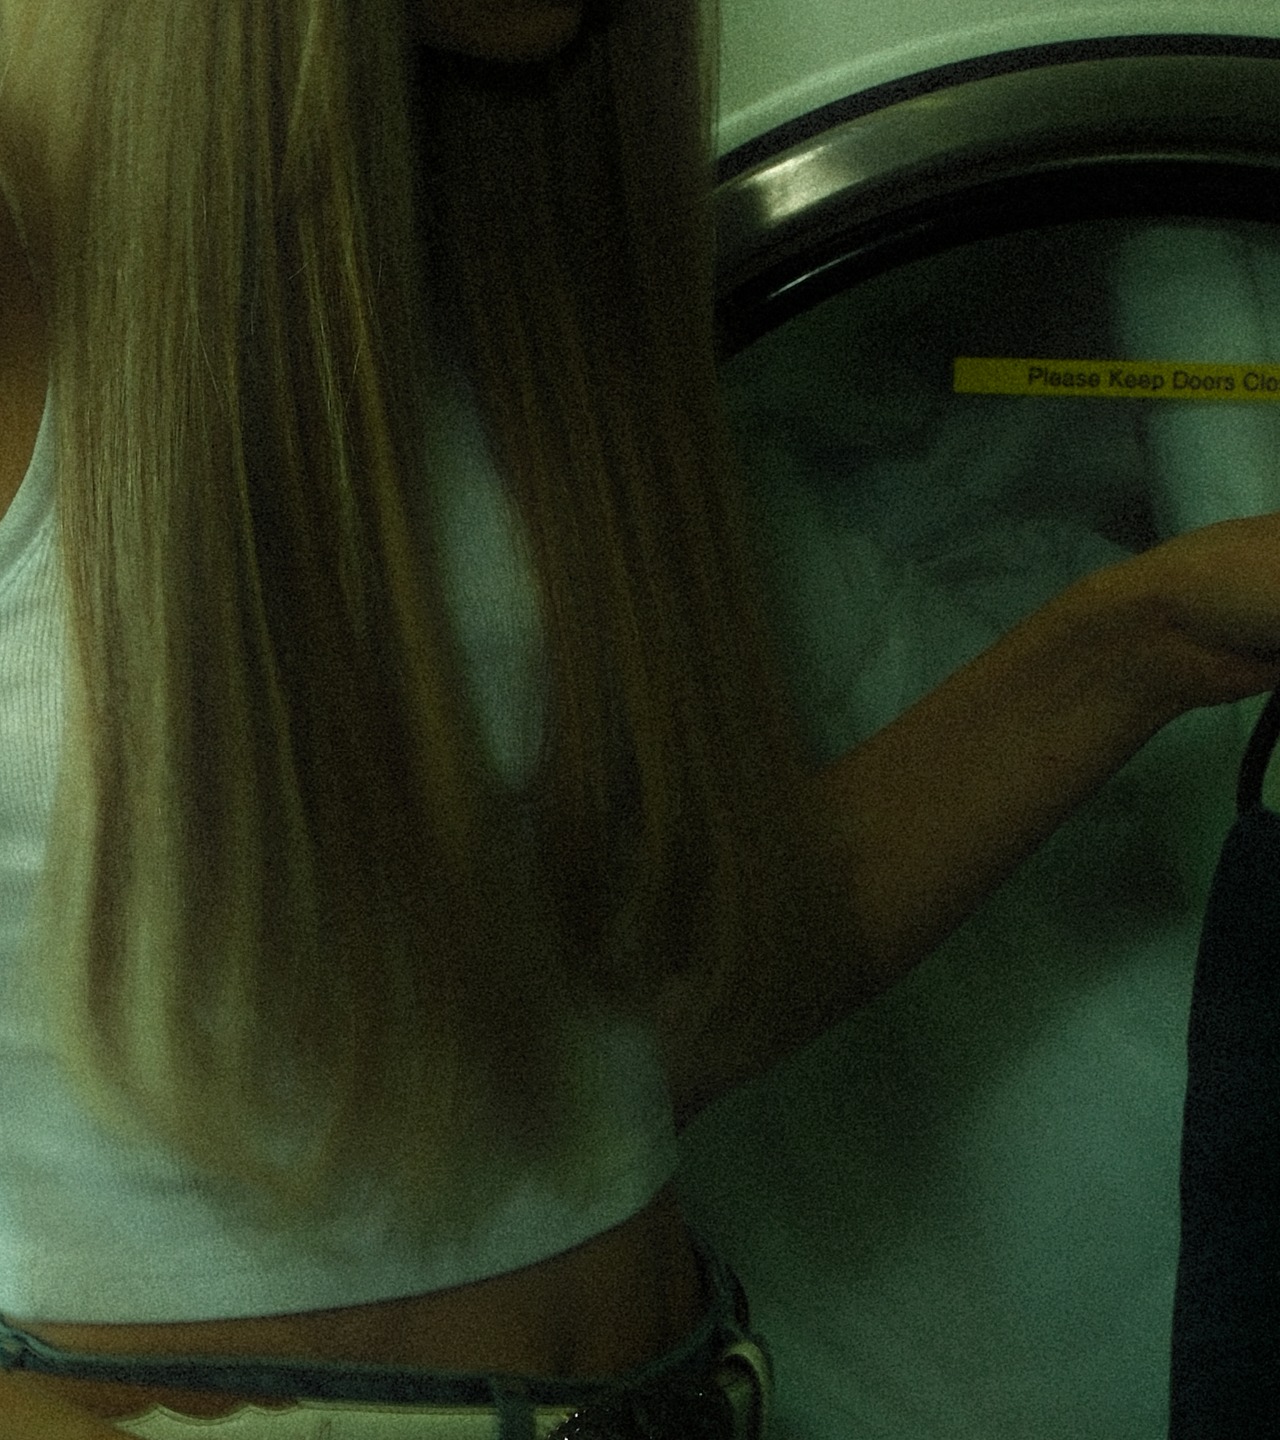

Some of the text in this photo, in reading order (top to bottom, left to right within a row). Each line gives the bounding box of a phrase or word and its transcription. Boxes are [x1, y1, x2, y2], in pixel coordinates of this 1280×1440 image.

[1027, 366, 1101, 388] Please
[1108, 369, 1165, 392] Keep
[1172, 370, 1235, 392] Doors
